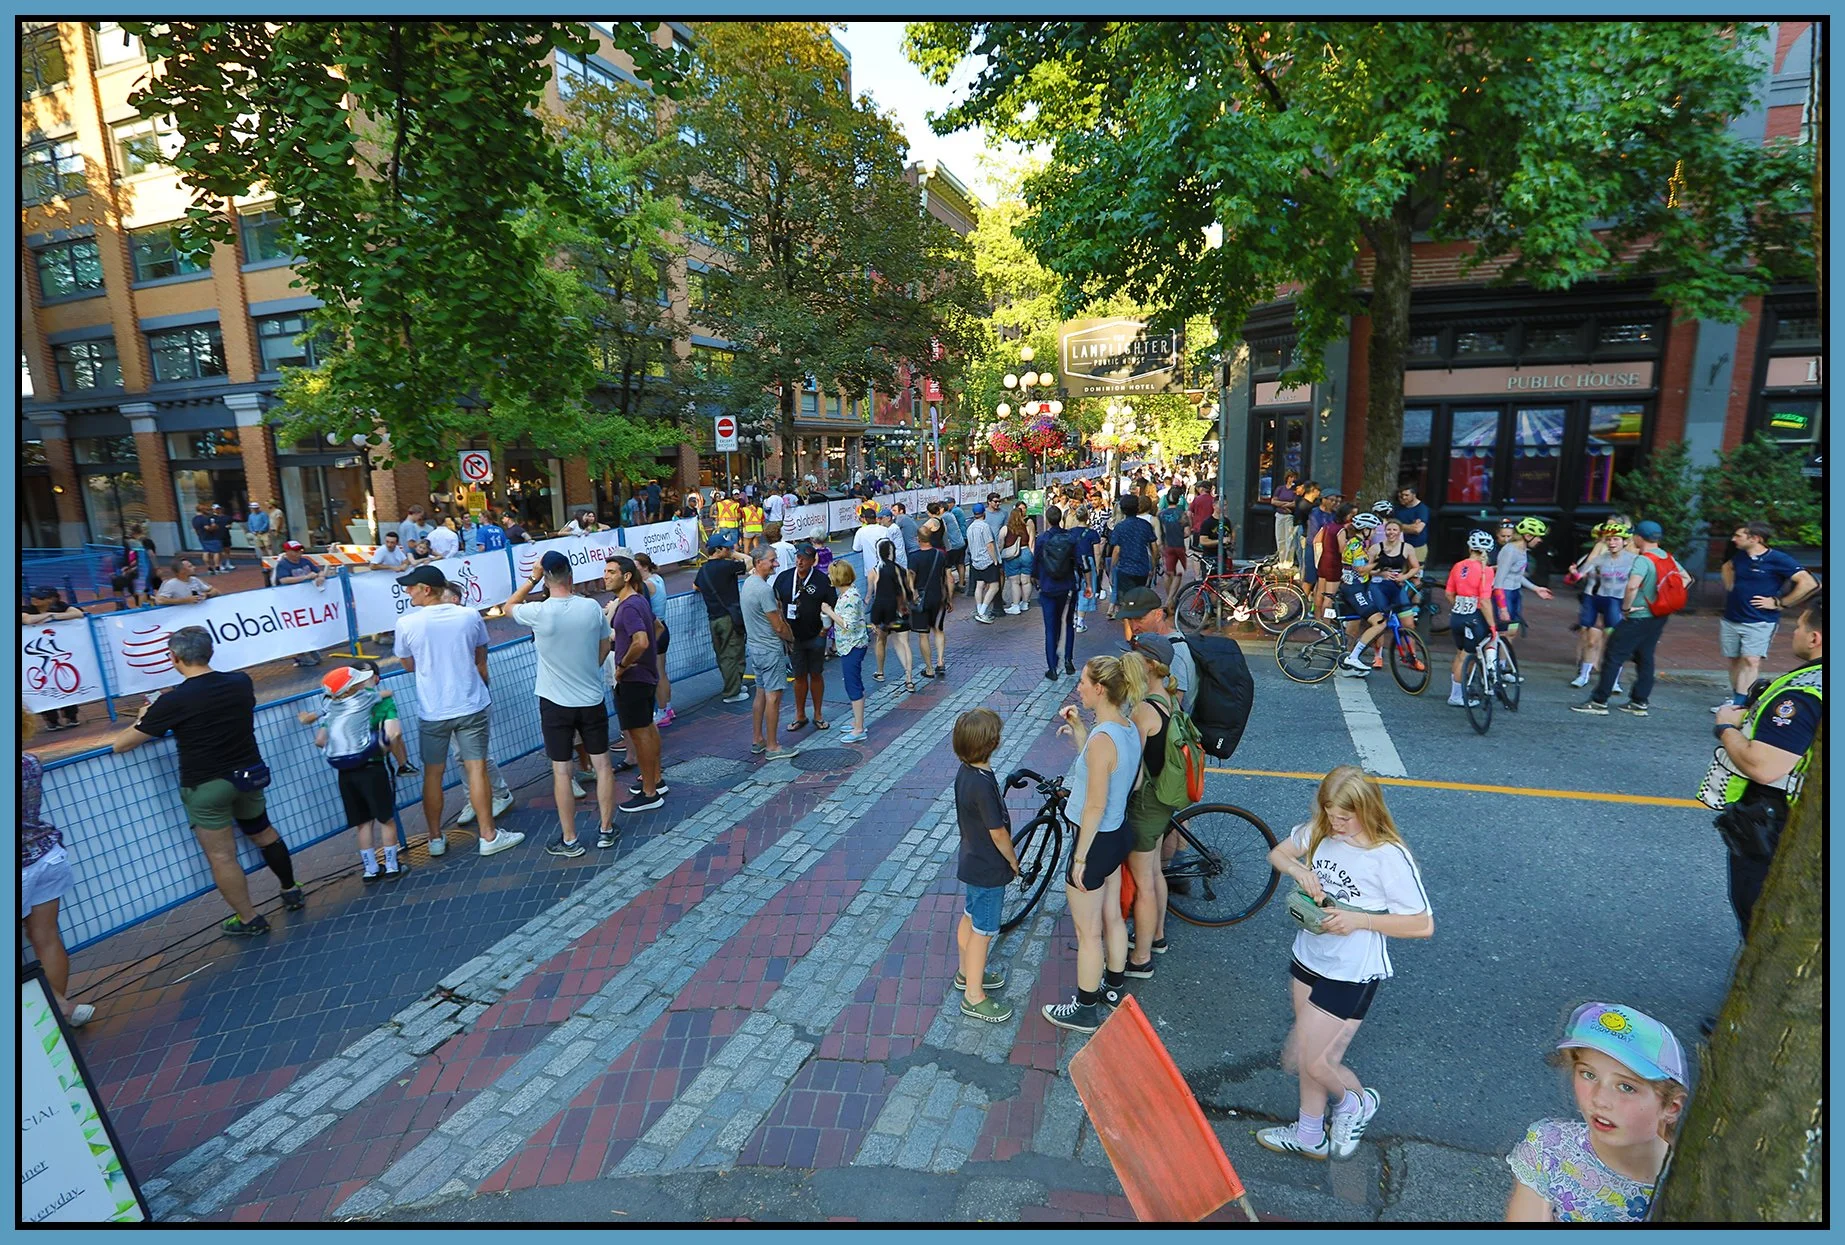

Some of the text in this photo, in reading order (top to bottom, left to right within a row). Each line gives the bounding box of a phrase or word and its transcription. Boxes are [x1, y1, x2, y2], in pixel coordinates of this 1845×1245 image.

[1072, 340, 1169, 360] LAMPLIGHTER
[1084, 383, 1156, 393] DOMINION HOTEL
[1507, 372, 1641, 389] PUBLIC HOUSE
[643, 532, 671, 547] gastown
[646, 539, 678, 556] grand prix
